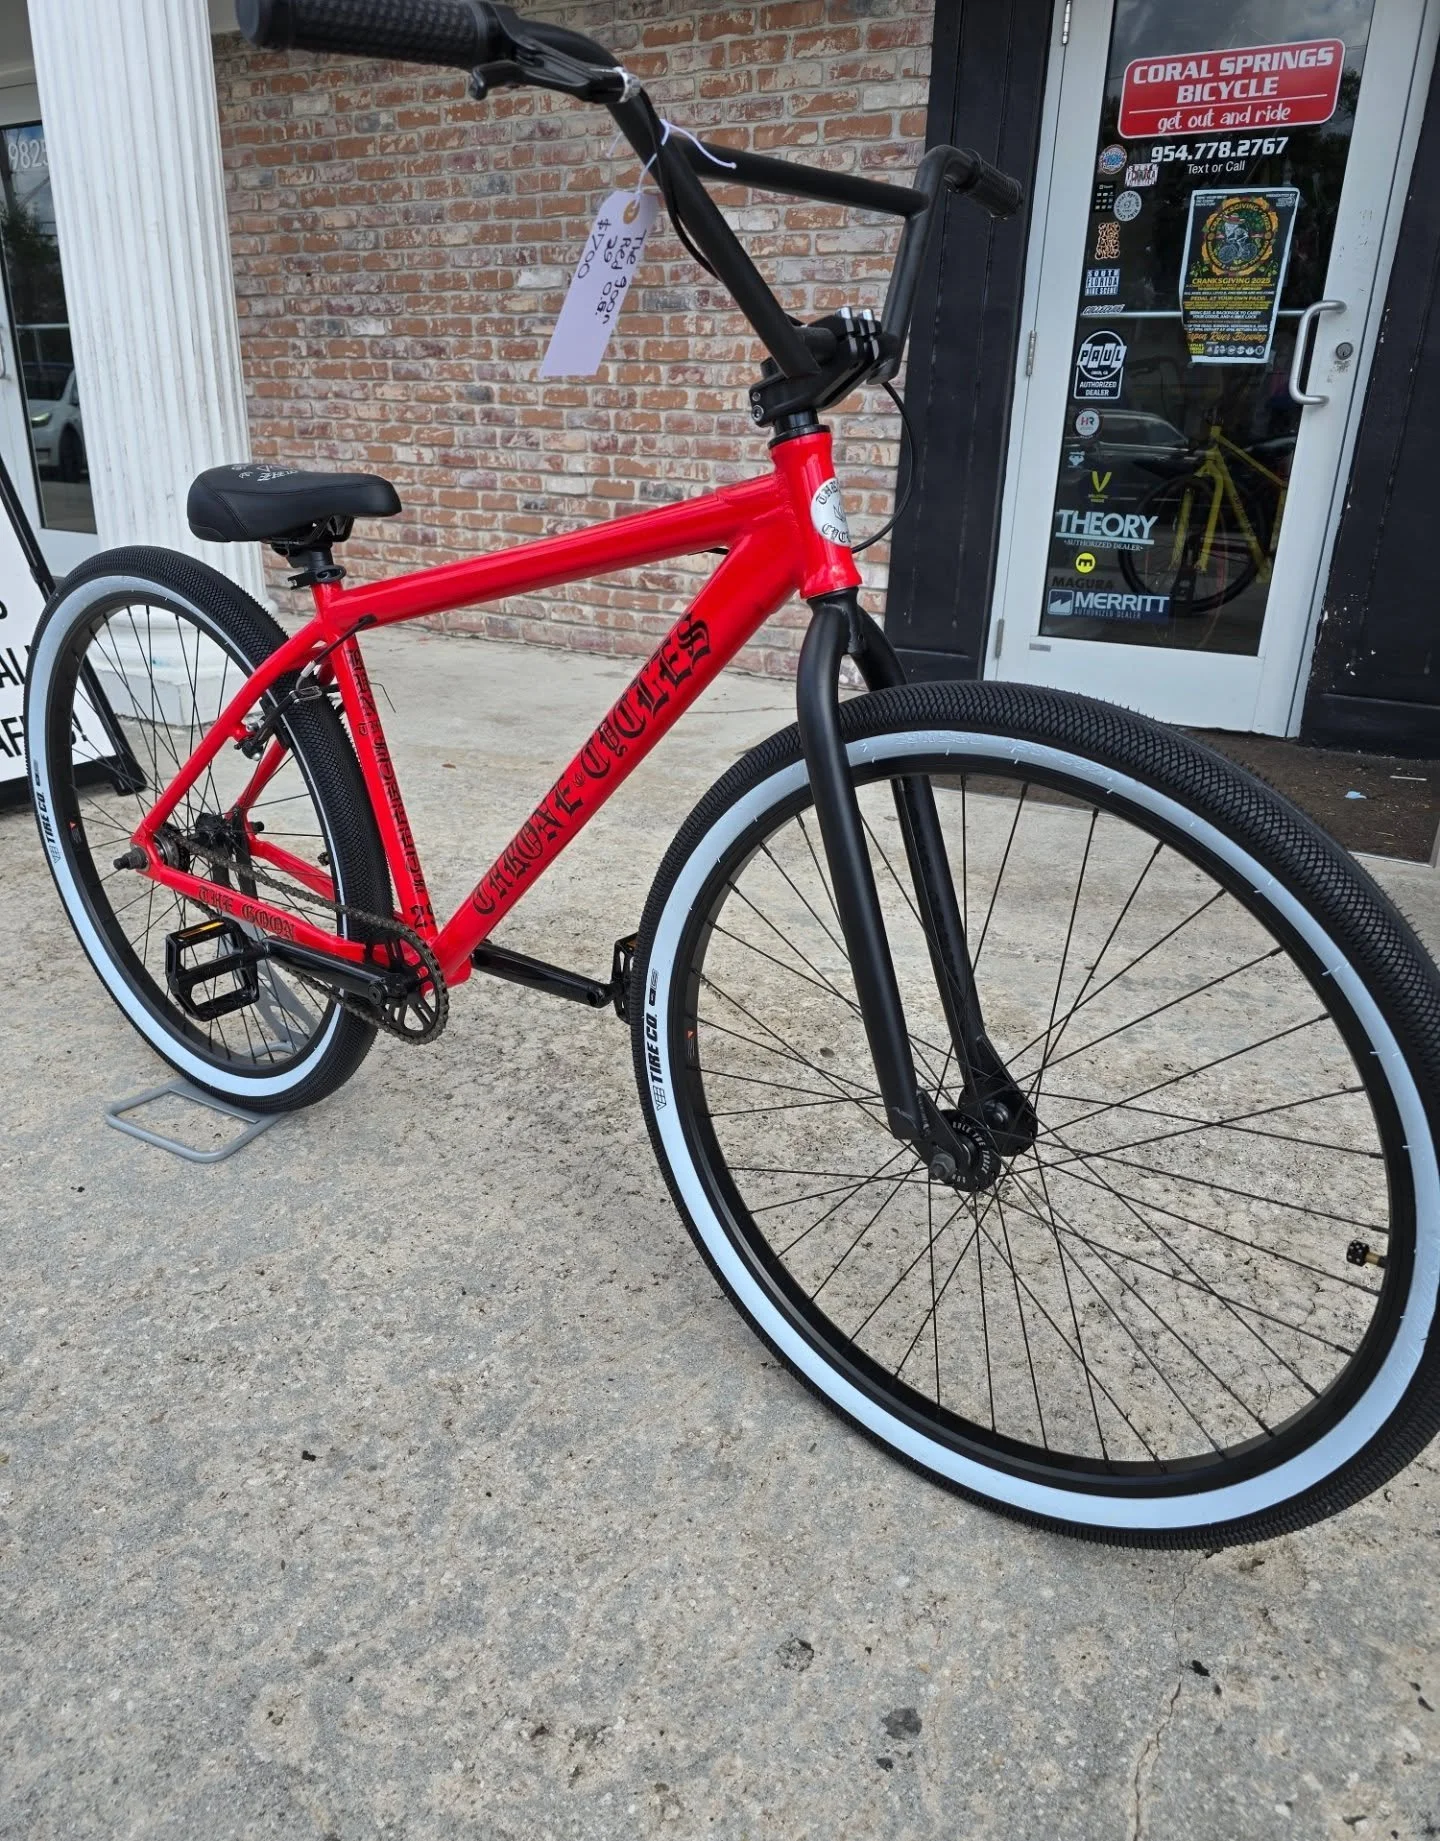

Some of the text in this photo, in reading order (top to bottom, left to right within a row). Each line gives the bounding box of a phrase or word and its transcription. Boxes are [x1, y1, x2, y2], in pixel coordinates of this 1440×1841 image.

[1133, 46, 1334, 84] CORAL SPRINGS
[1176, 76, 1280, 104] BICYCLE
[1158, 102, 1291, 134] get out and ride
[1151, 137, 1289, 163] 954.778.2767
[1187, 160, 1245, 174] Text or Call
[577, 218, 612, 279] $700
[604, 235, 618, 263] 29
[611, 237, 632, 270] Red
[626, 229, 647, 265] The
[1087, 276, 1119, 287] FLORIDA
[1192, 277, 1250, 285] CRANKSGIVING
[1056, 509, 1159, 539] THEORY
[1052, 576, 1113, 589] MAGURA
[1074, 609, 1140, 619] AUTHORIZED DEALER
[1075, 591, 1170, 613] MERRITT
[41, 815, 56, 843] TIRE
[646, 1012, 658, 1042] CO.
[647, 1041, 663, 1084] TIRE
